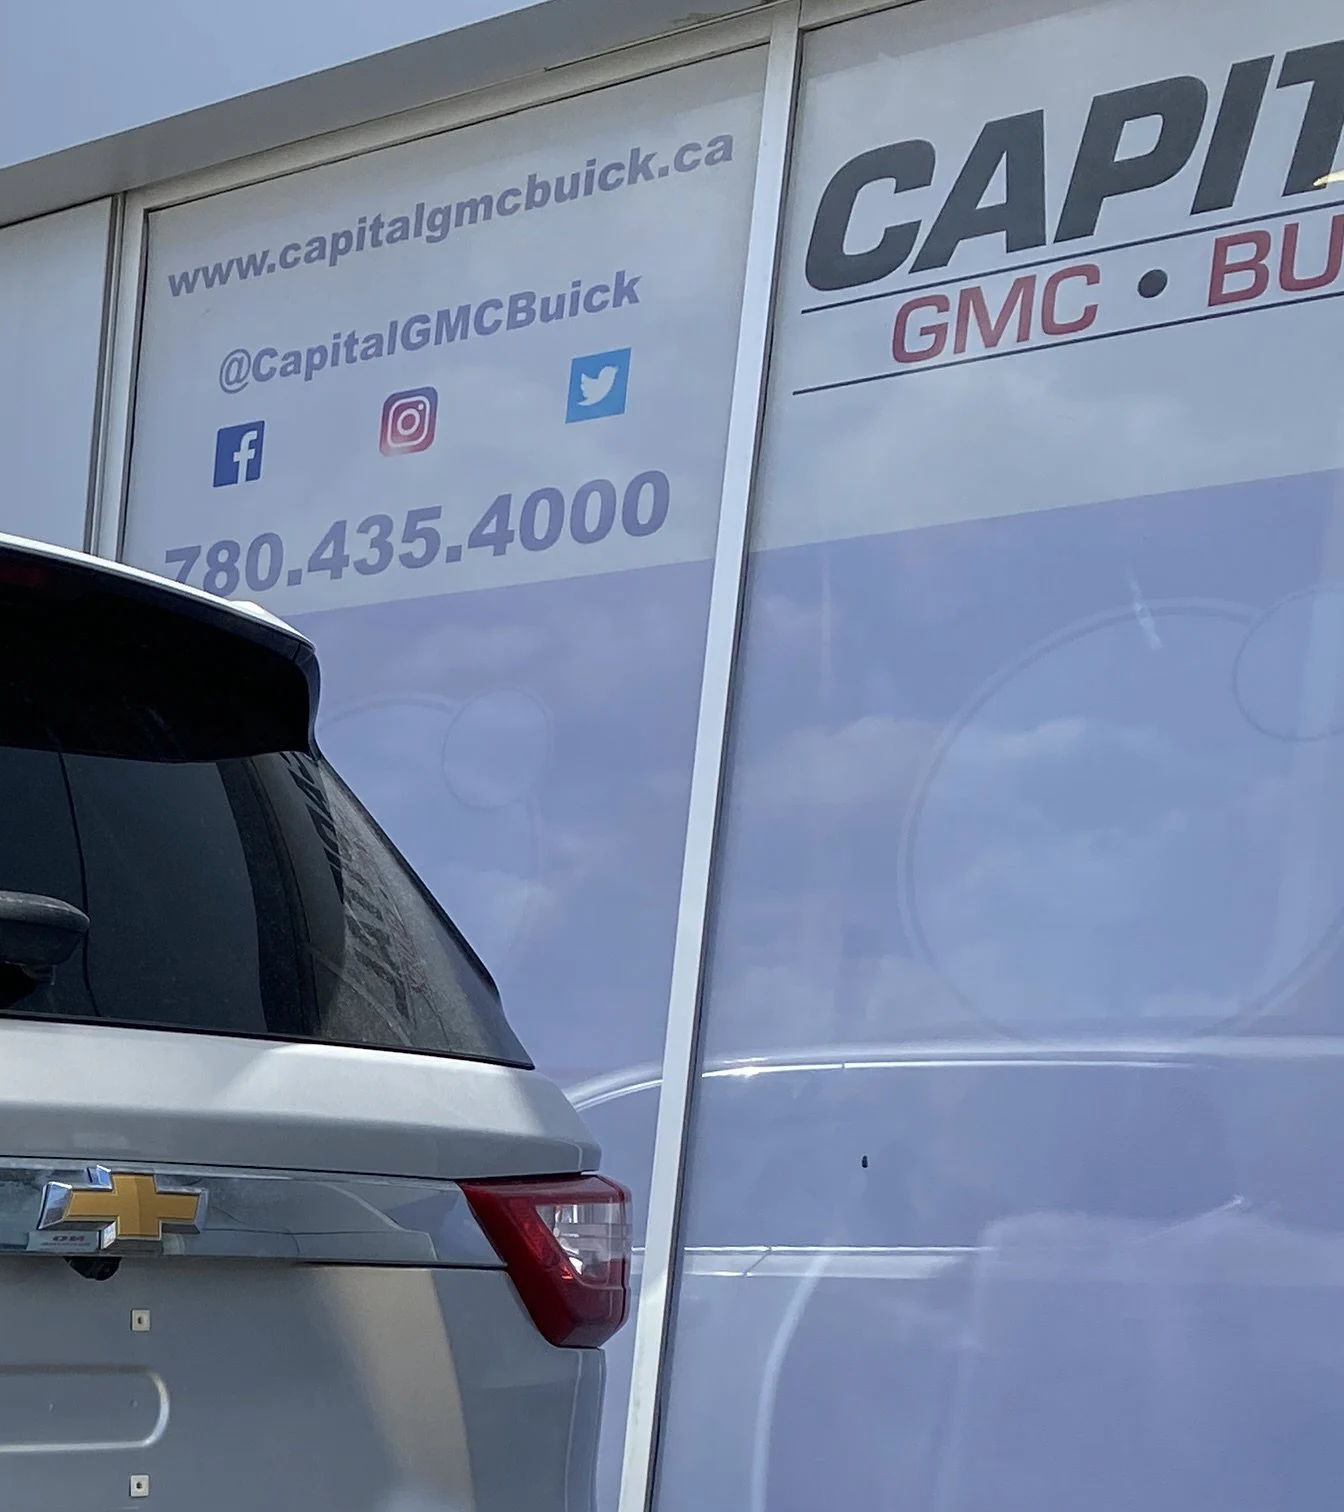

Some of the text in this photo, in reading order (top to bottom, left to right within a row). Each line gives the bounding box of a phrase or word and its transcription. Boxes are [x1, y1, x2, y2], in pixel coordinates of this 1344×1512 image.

[167, 133, 735, 298] www.capitalgmcbuick.ca
[805, 40, 1344, 292] CAPIT
[219, 270, 643, 394] @CapitalGMCBuick
[892, 214, 1344, 364] GMC BU
[165, 470, 671, 598] 780.435.4000
